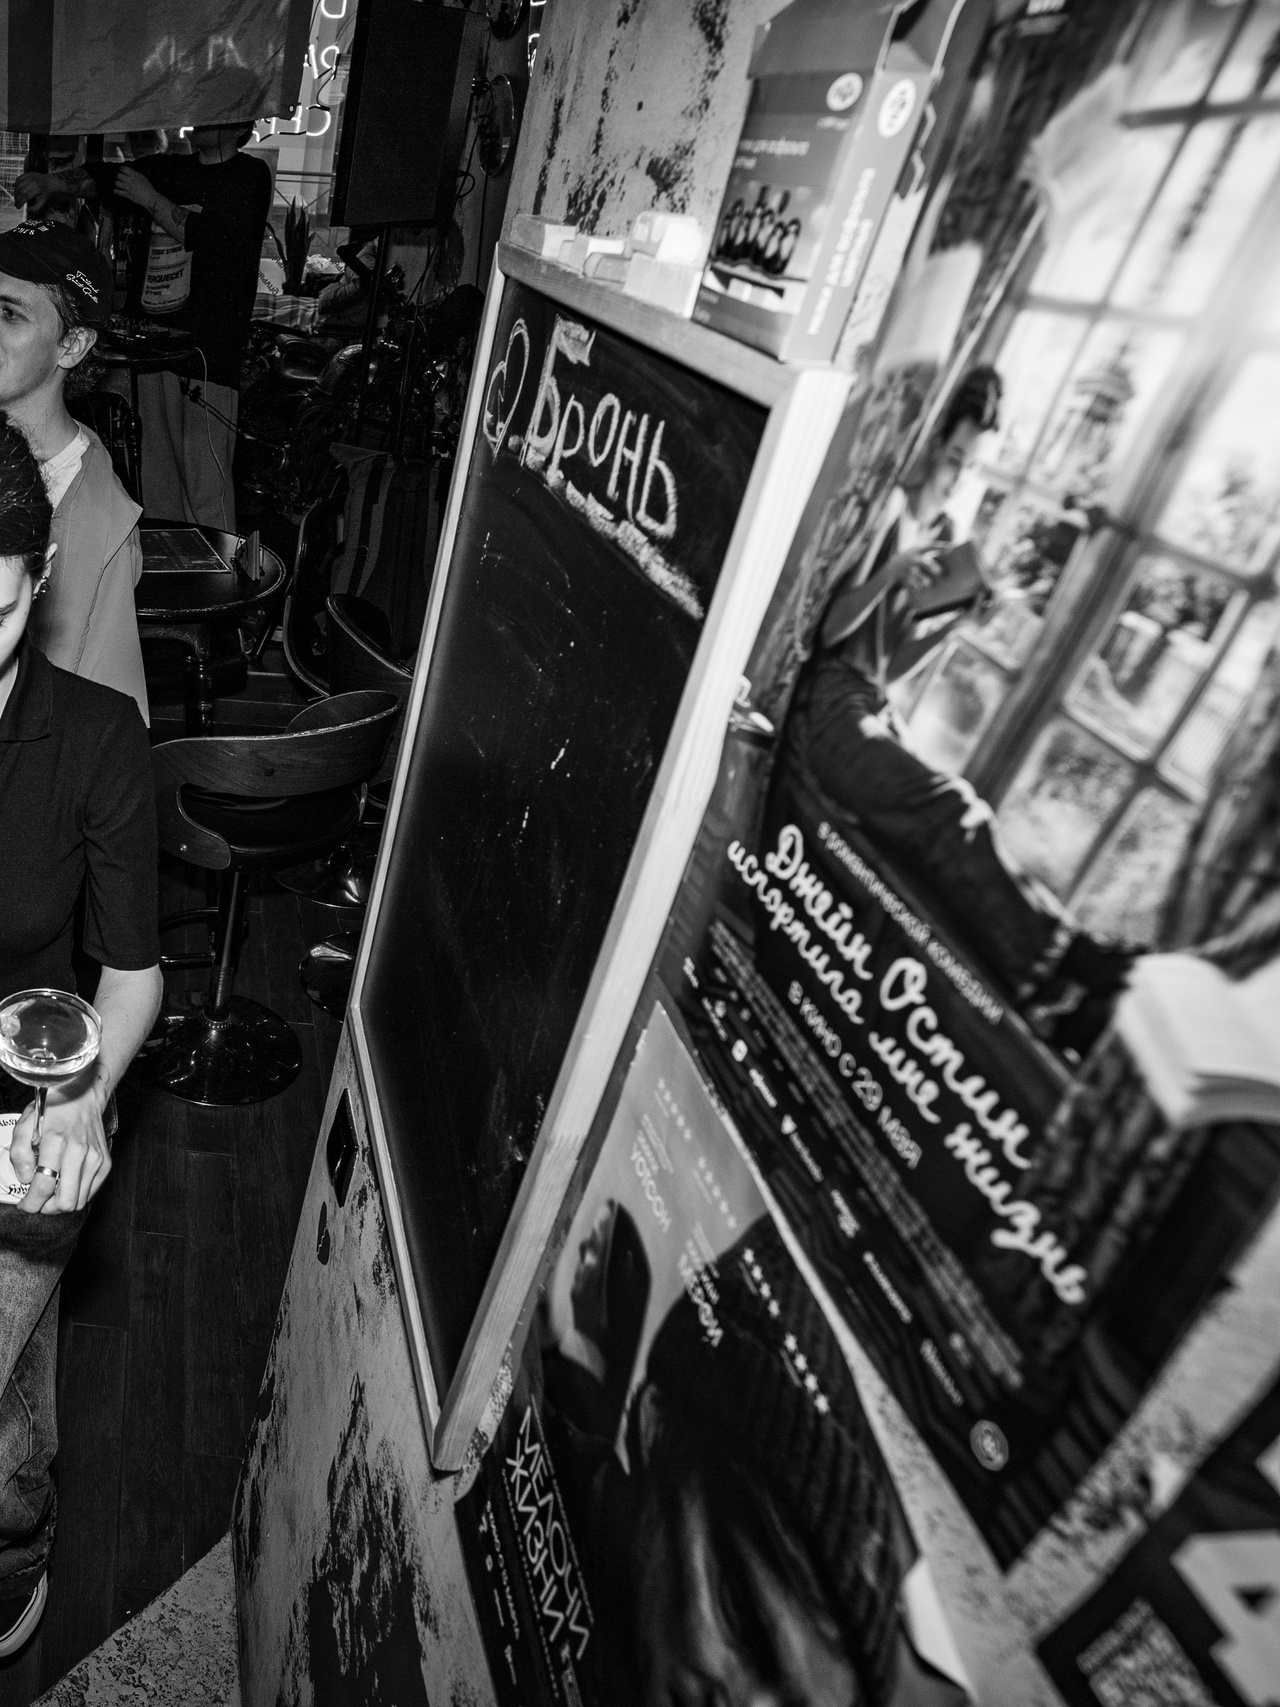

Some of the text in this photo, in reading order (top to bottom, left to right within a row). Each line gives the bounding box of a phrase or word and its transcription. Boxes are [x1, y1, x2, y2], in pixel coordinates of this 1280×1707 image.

[727, 839, 865, 1025] испортила
[867, 1031, 942, 1125] мне
[943, 1121, 1088, 1305] жизнь
[765, 823, 873, 981] Джейн
[879, 956, 1033, 1169] Остин
[505, 1436, 566, 1643] ЖИЗНИ
[519, 1405, 590, 1661] МЕЛОЧИ
